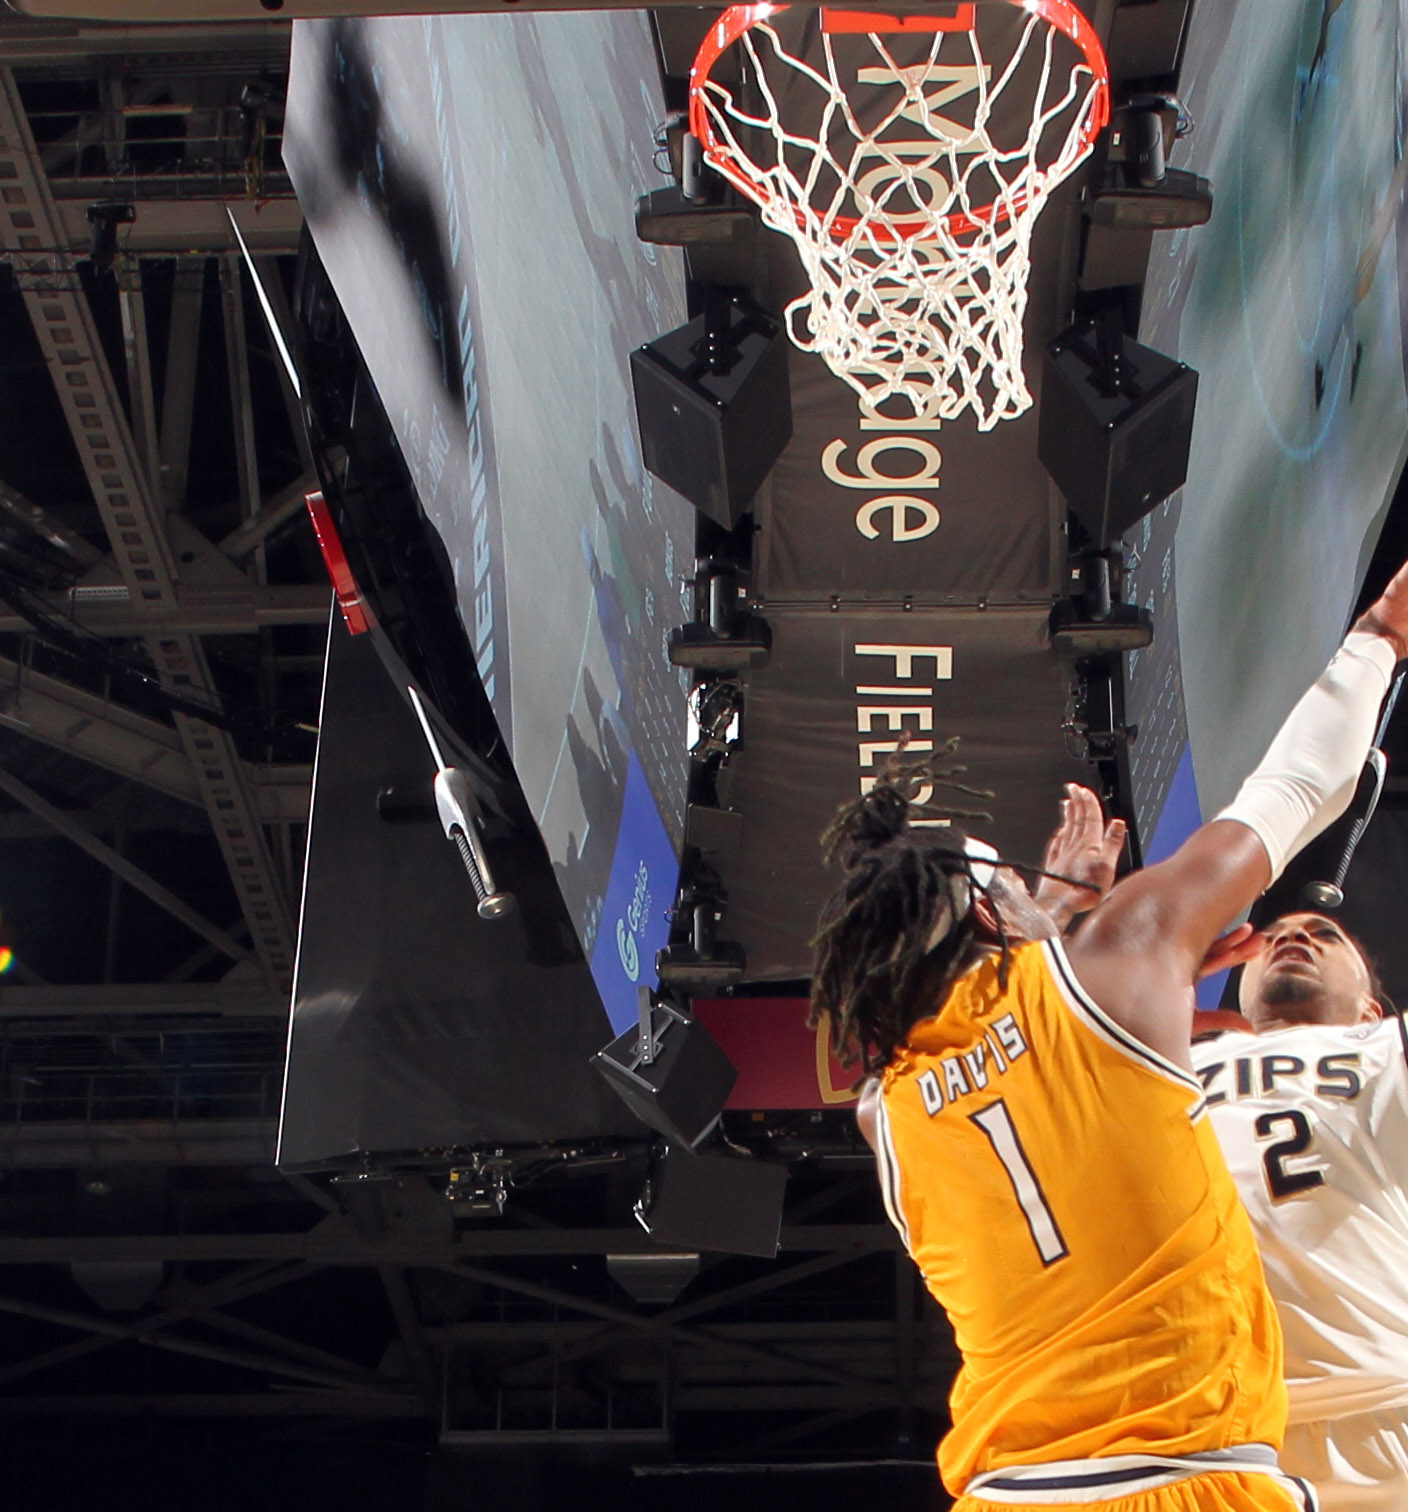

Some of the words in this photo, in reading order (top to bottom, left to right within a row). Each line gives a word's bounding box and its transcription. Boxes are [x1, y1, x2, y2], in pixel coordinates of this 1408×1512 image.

[915, 1010, 1030, 1118] DAVIS
[1194, 1052, 1363, 1103] ZIPS
[970, 1097, 1070, 1268] 1
[1254, 1109, 1325, 1204] 2
